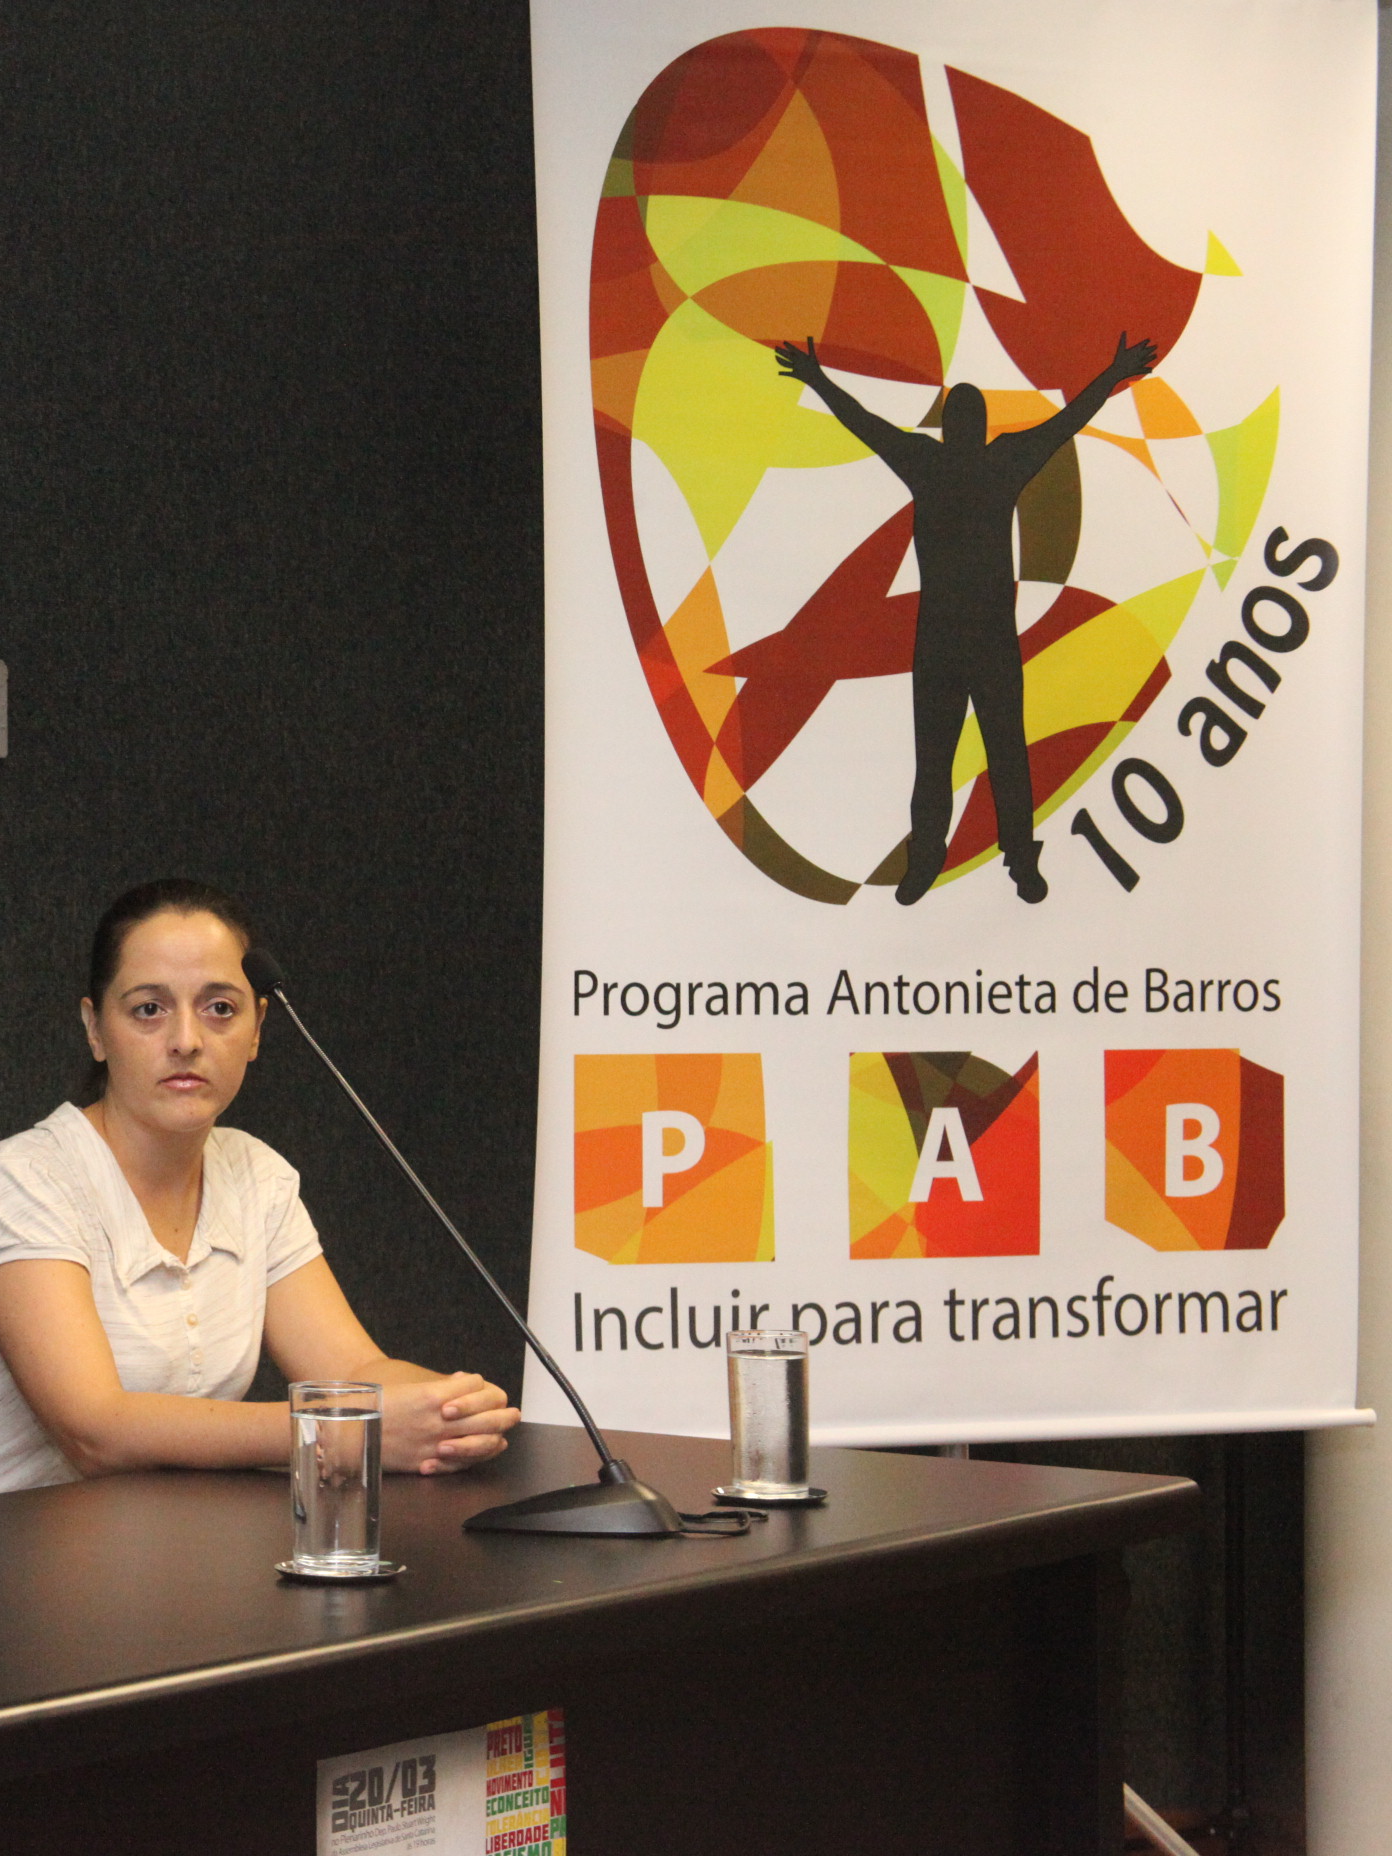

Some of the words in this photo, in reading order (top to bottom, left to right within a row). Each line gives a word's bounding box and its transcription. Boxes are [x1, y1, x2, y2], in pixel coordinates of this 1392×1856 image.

[1071, 757, 1185, 893] 10
[1178, 525, 1340, 768] anos
[574, 969, 809, 1030] Programa
[826, 968, 1057, 1016] Antonieta
[1072, 965, 1129, 1014] de
[1144, 967, 1281, 1013] Barros
[642, 1110, 706, 1208] P
[908, 1107, 984, 1203] A
[1165, 1102, 1224, 1197] B
[574, 1286, 771, 1352] Incluir
[791, 1300, 922, 1347] para
[943, 1275, 1289, 1342] transformar
[487, 1724, 523, 1760] PRETO
[331, 1774, 349, 1834] DIA
[349, 1754, 436, 1812] 20/03
[486, 1785, 550, 1818] ECONCEITO
[349, 1793, 436, 1833] QUINTA-FEIRA
[486, 1823, 550, 1855] LIBERDADE
